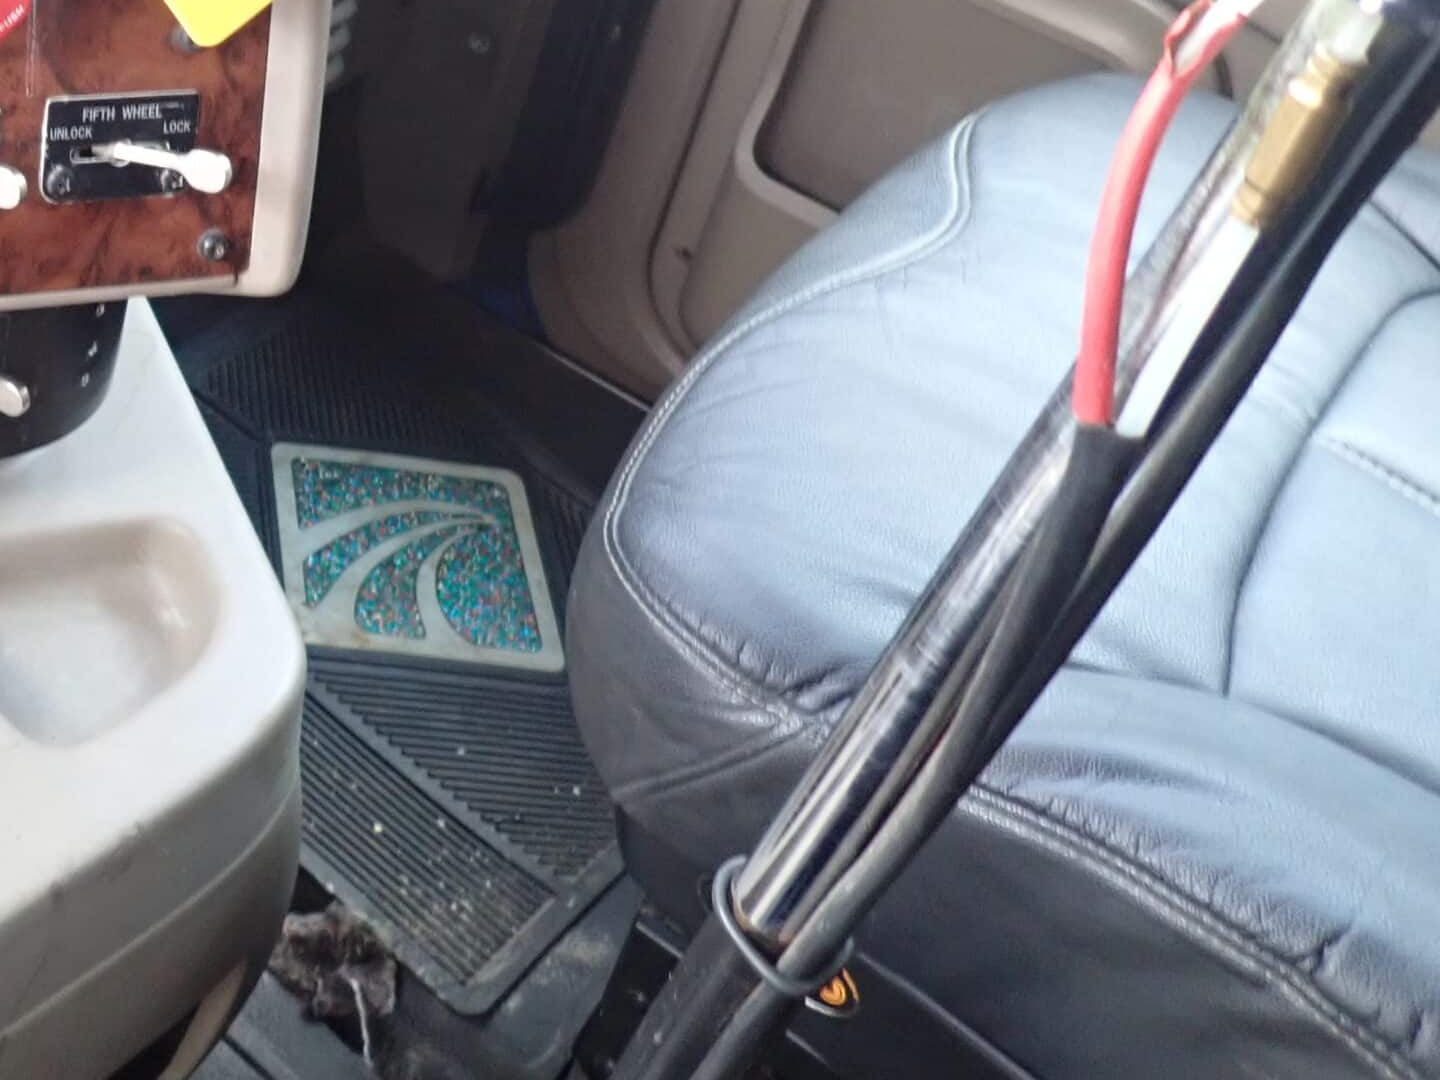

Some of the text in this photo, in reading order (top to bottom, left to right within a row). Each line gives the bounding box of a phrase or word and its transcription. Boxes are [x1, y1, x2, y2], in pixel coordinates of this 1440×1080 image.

[82, 103, 162, 123] FIFTH WHEEL
[50, 126, 93, 141] UNLOCK
[163, 120, 192, 135] LOCK
